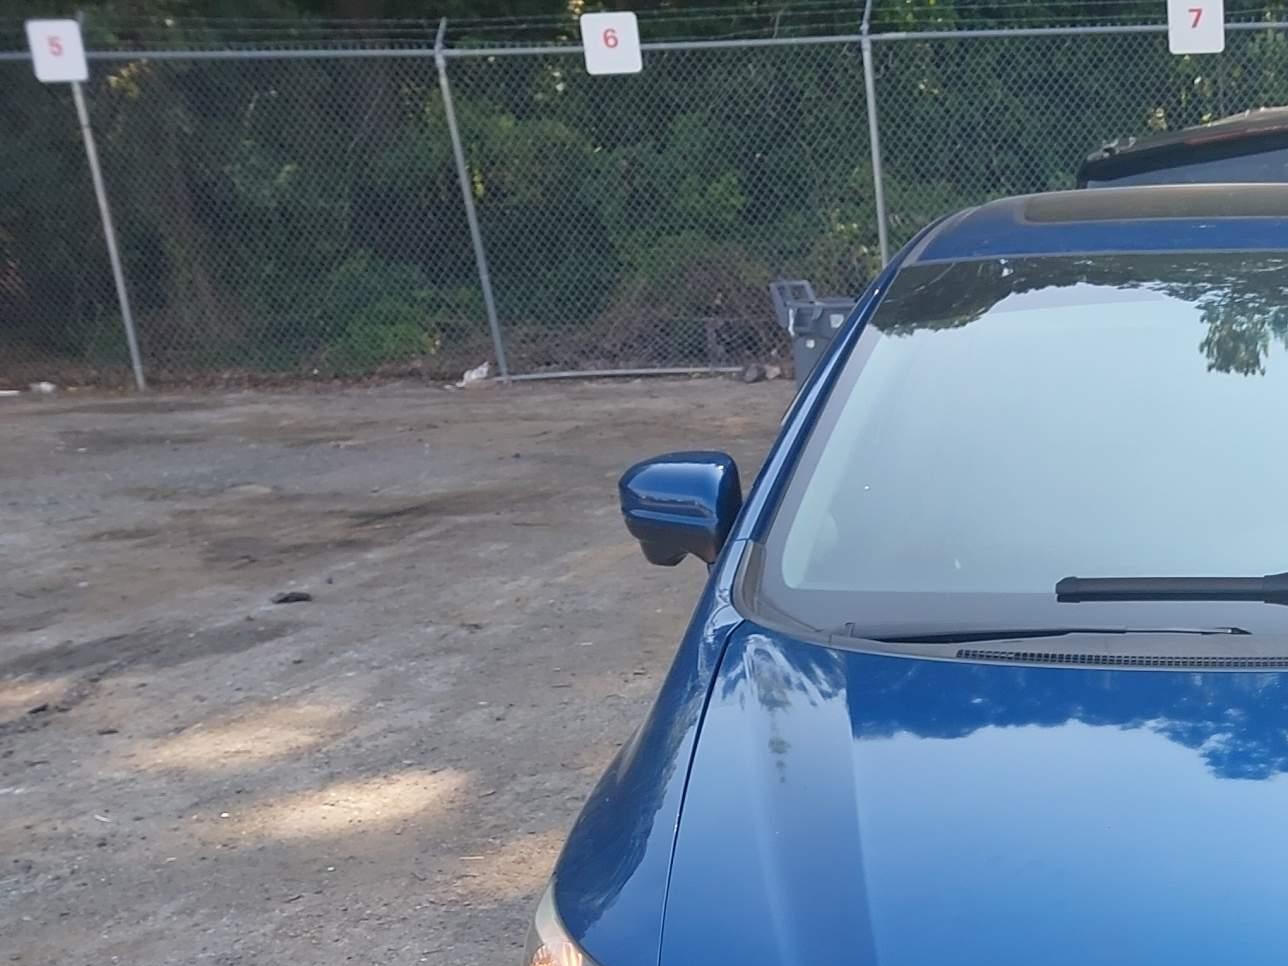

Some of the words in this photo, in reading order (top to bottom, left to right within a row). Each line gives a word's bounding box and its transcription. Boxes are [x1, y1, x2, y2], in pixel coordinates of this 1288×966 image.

[1188, 8, 1202, 28] 7
[48, 35, 63, 56] 5
[603, 28, 618, 48] 6
